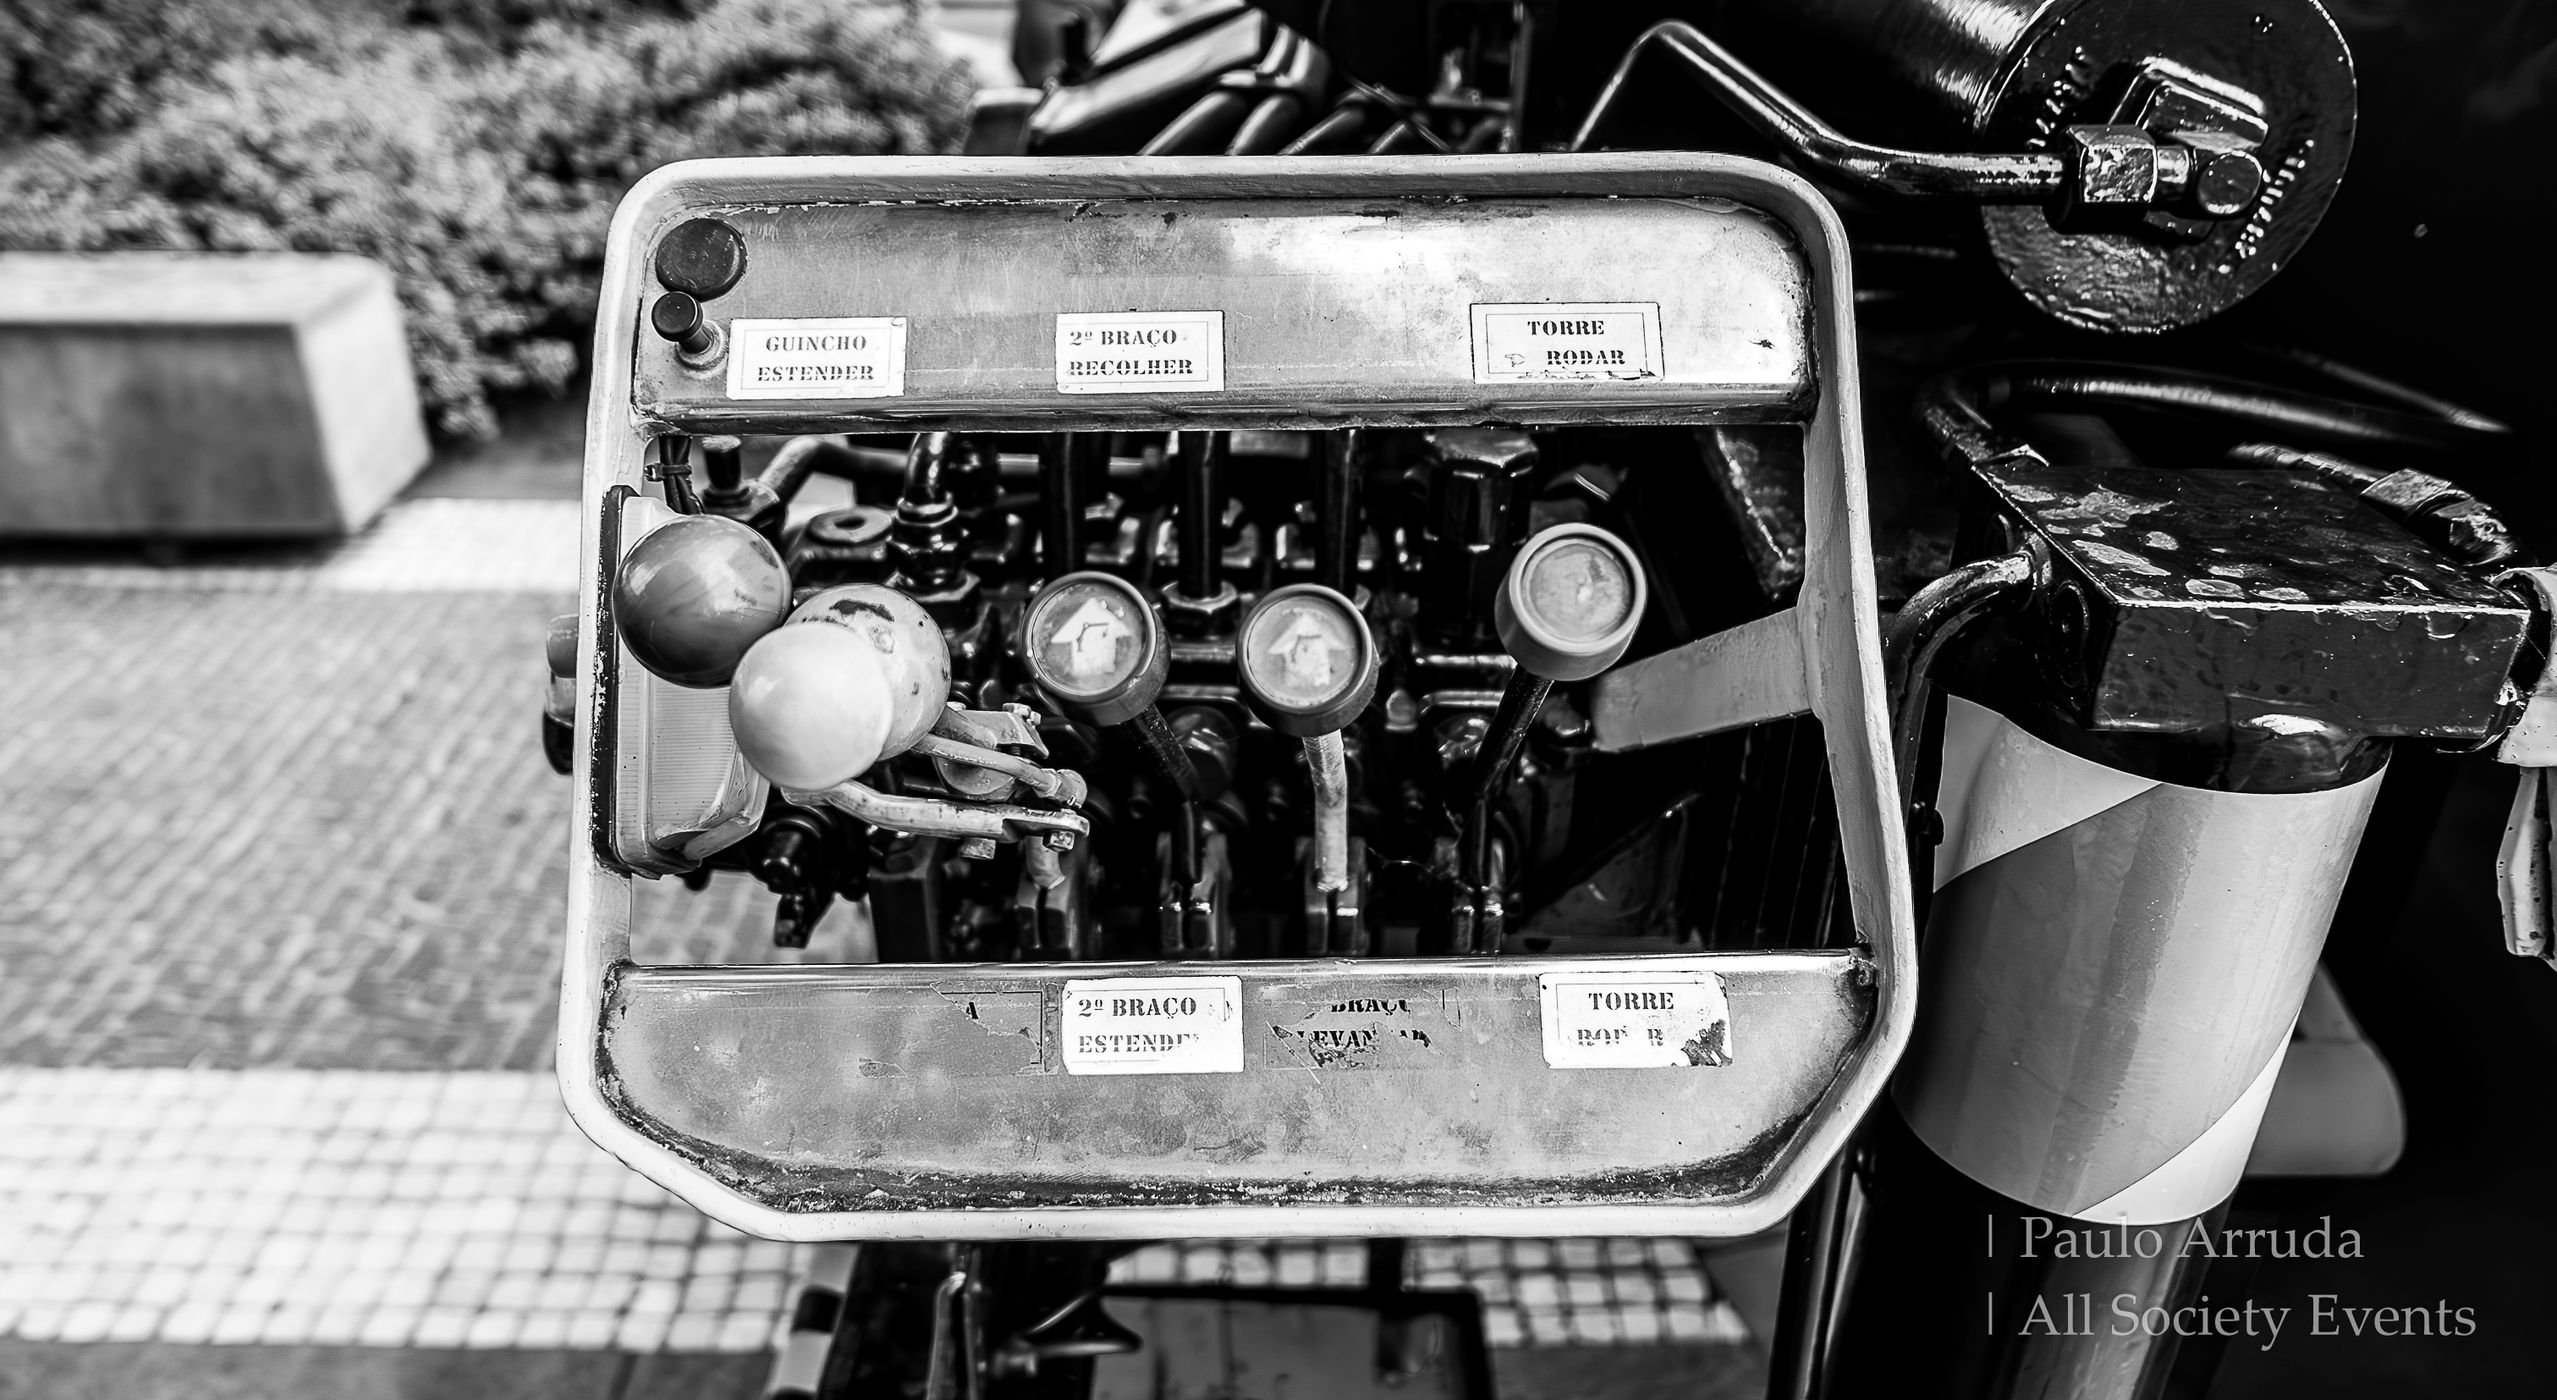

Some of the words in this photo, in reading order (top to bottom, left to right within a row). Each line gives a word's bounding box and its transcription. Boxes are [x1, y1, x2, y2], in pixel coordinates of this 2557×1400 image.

[1527, 320, 1605, 336] TORRE
[765, 335, 867, 352] GUINCHO
[1101, 329, 1177, 347] BRAÇO
[1546, 350, 1626, 365] RODAR
[757, 365, 874, 382] ESTENDER
[1069, 359, 1193, 376] RECOLHER
[1112, 997, 1197, 1019] BRAÇO
[1588, 992, 1674, 1010] TORRE
[1079, 1034, 1199, 1053] ESTEND
